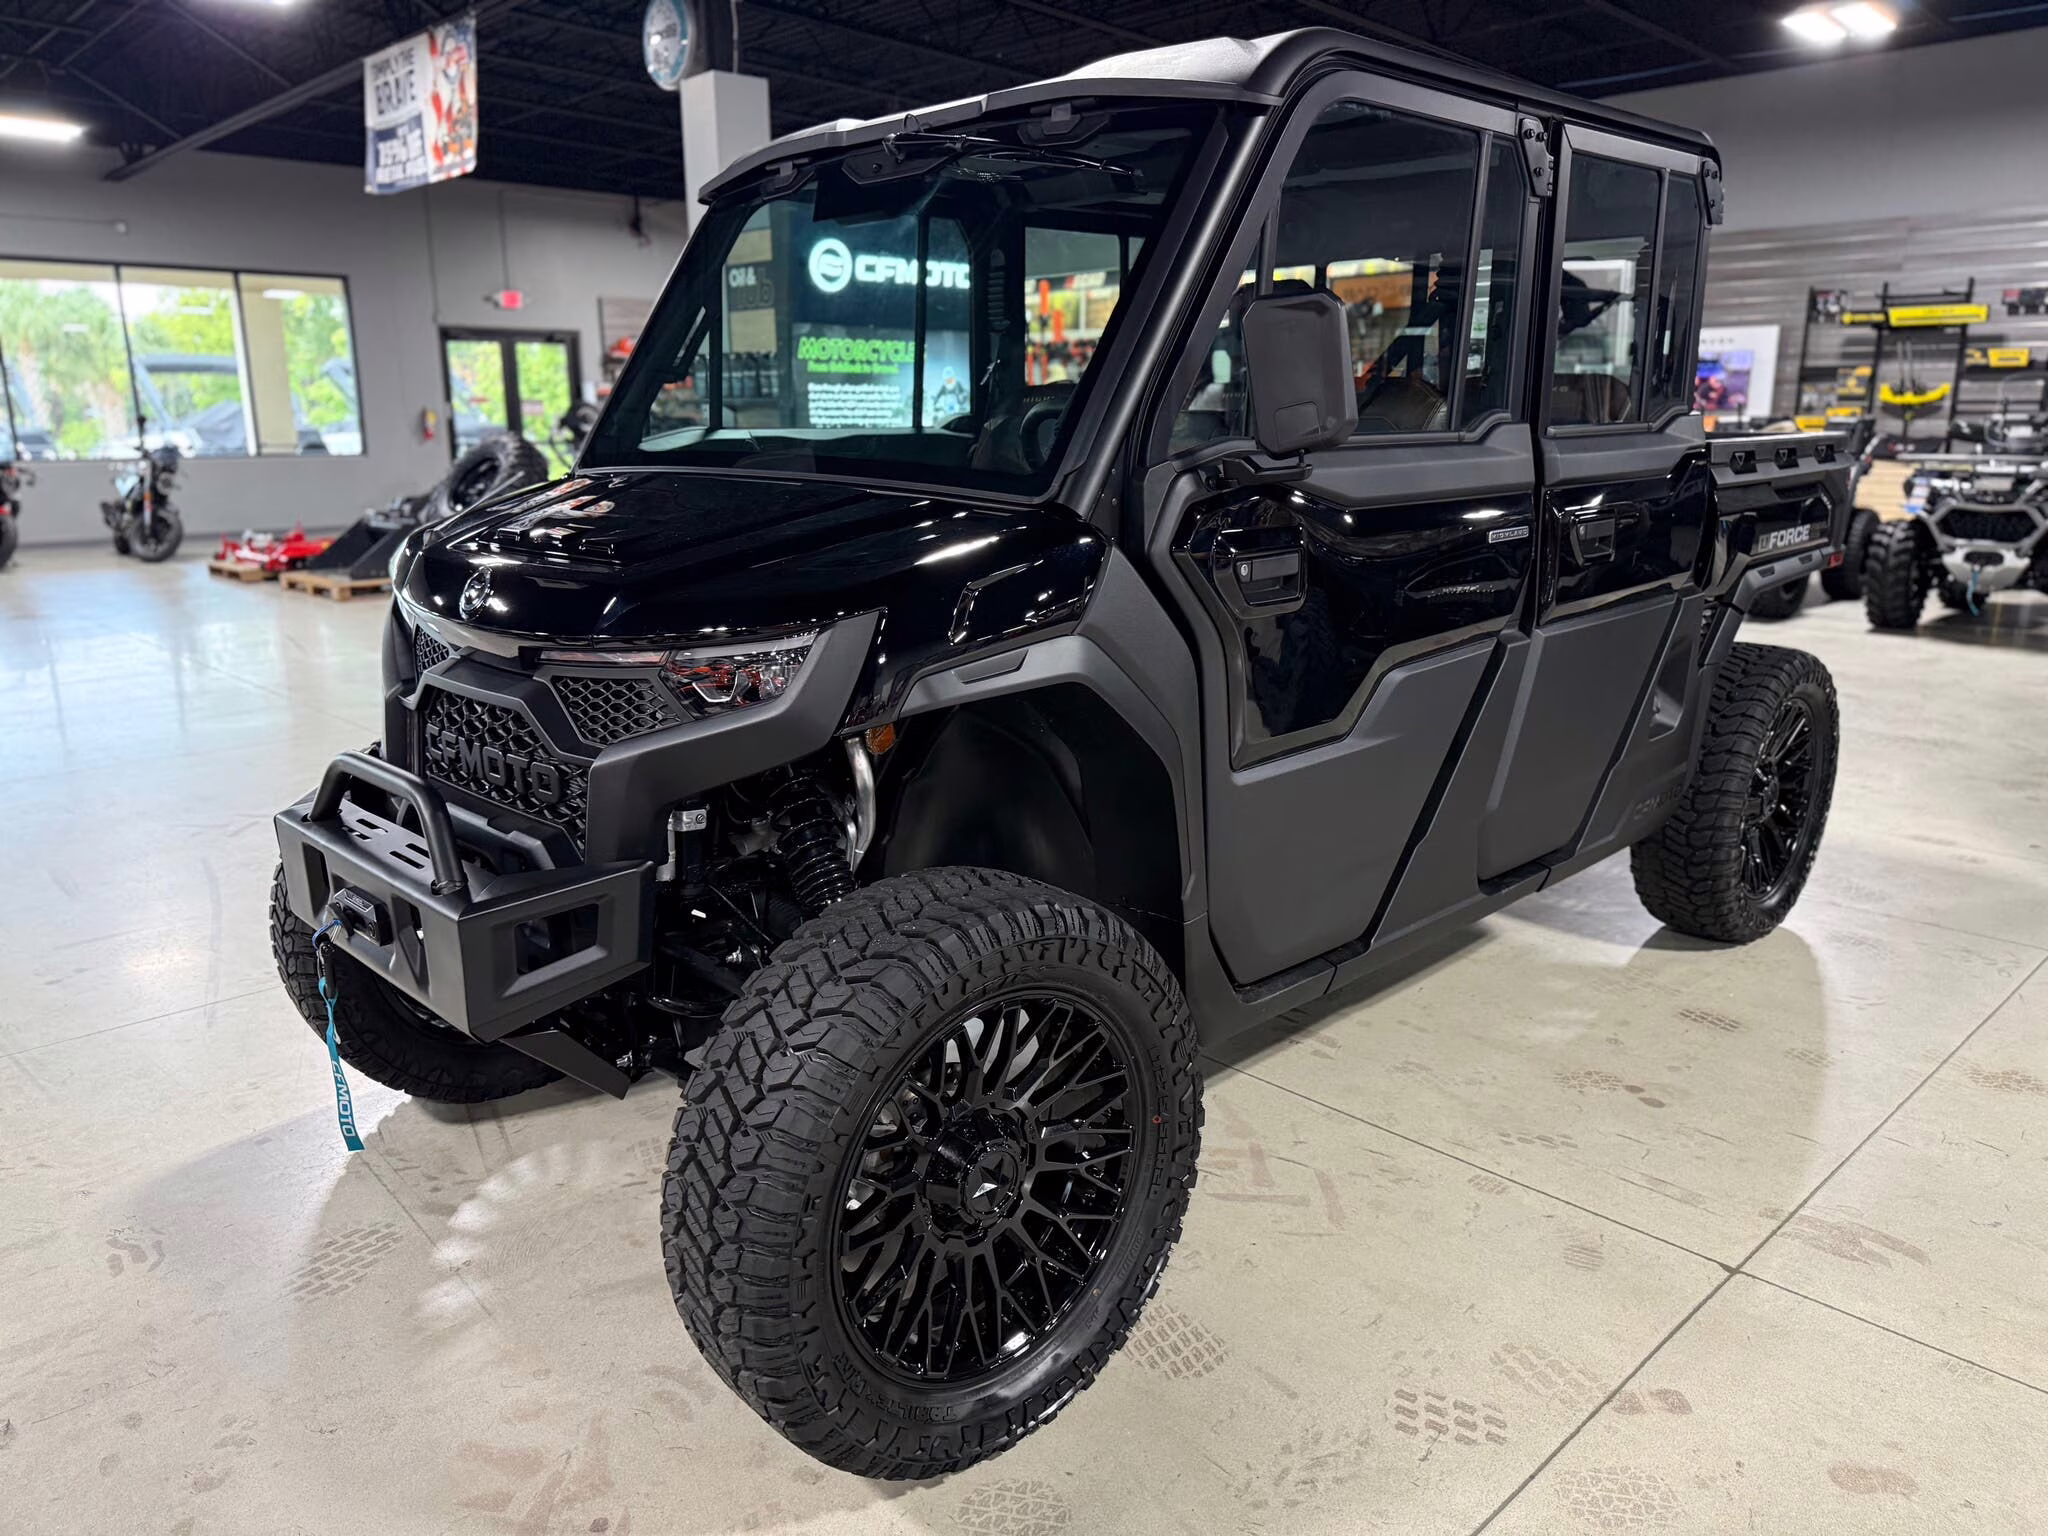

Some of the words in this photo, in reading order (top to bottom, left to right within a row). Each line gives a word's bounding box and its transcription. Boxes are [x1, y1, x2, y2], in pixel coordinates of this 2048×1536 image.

[797, 336, 927, 363] MOTORCYCLE
[426, 723, 561, 804] CFMOTO
[332, 1060, 356, 1137] CFMOTO
